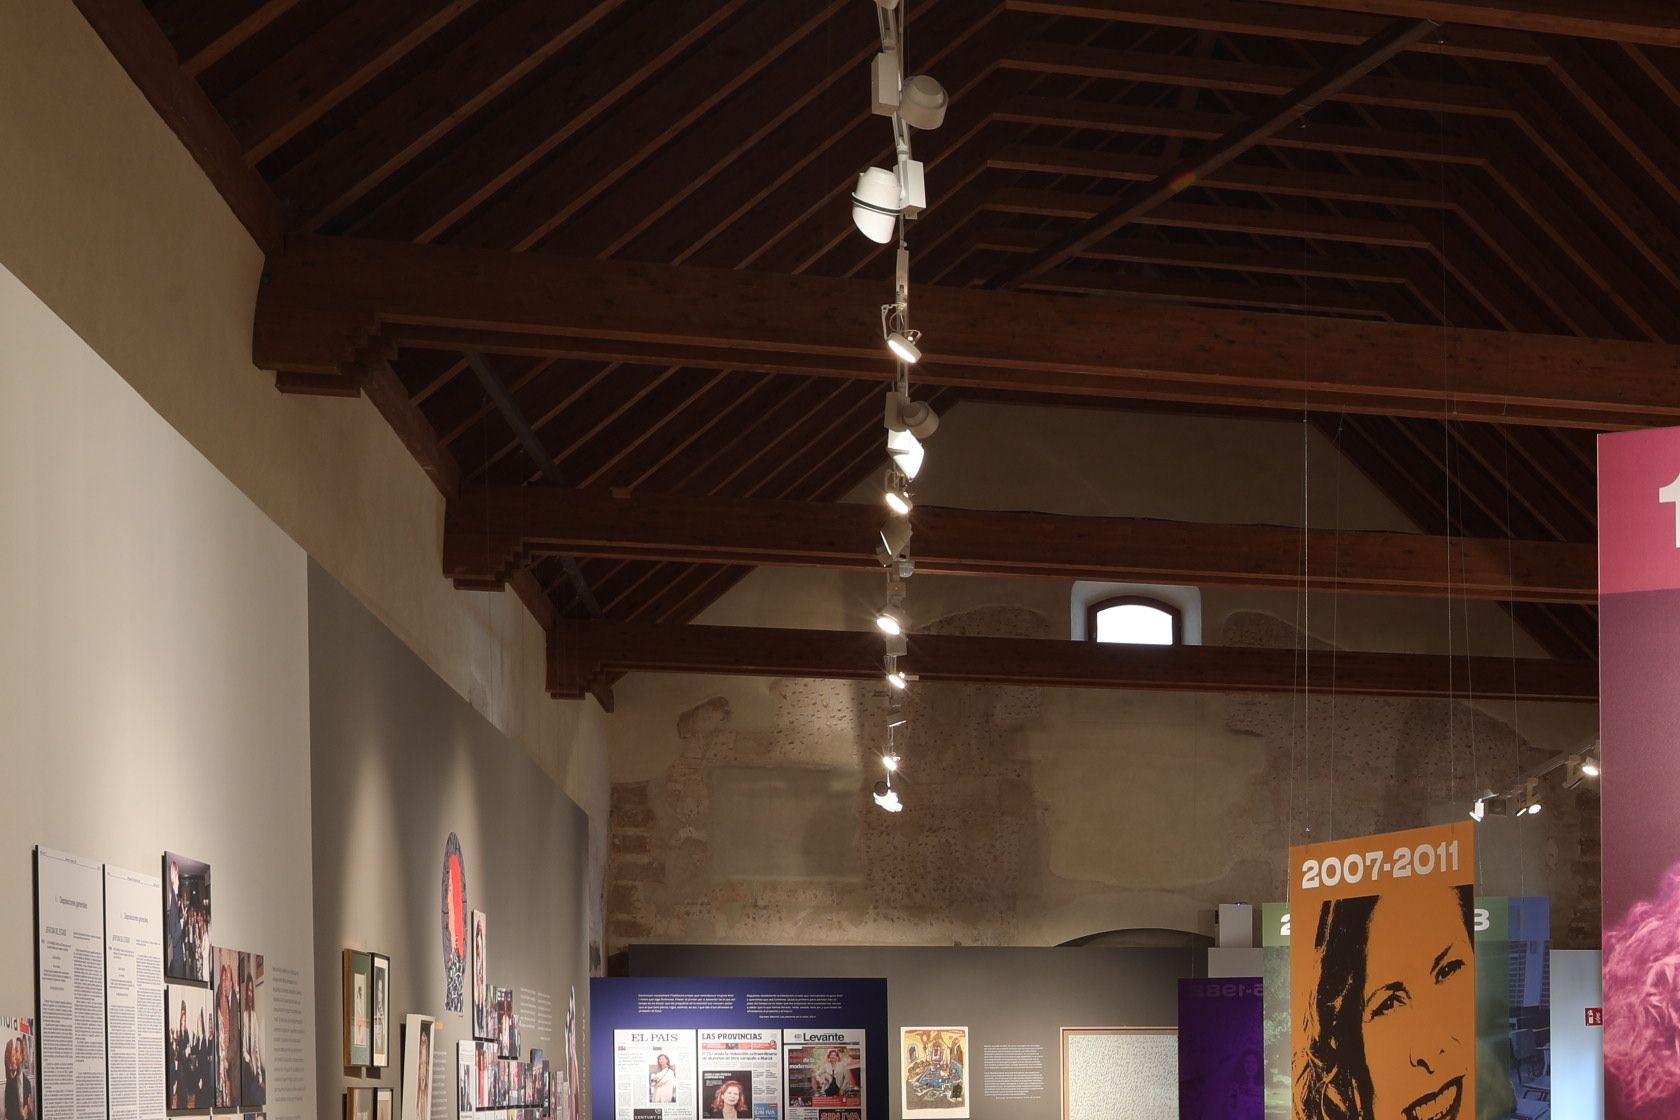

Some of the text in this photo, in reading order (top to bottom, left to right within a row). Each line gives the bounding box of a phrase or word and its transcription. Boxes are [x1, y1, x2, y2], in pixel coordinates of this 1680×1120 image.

[1302, 840, 1459, 889] 2007-2011
[631, 1034, 648, 1042] EL
[803, 1032, 845, 1042] Levante
